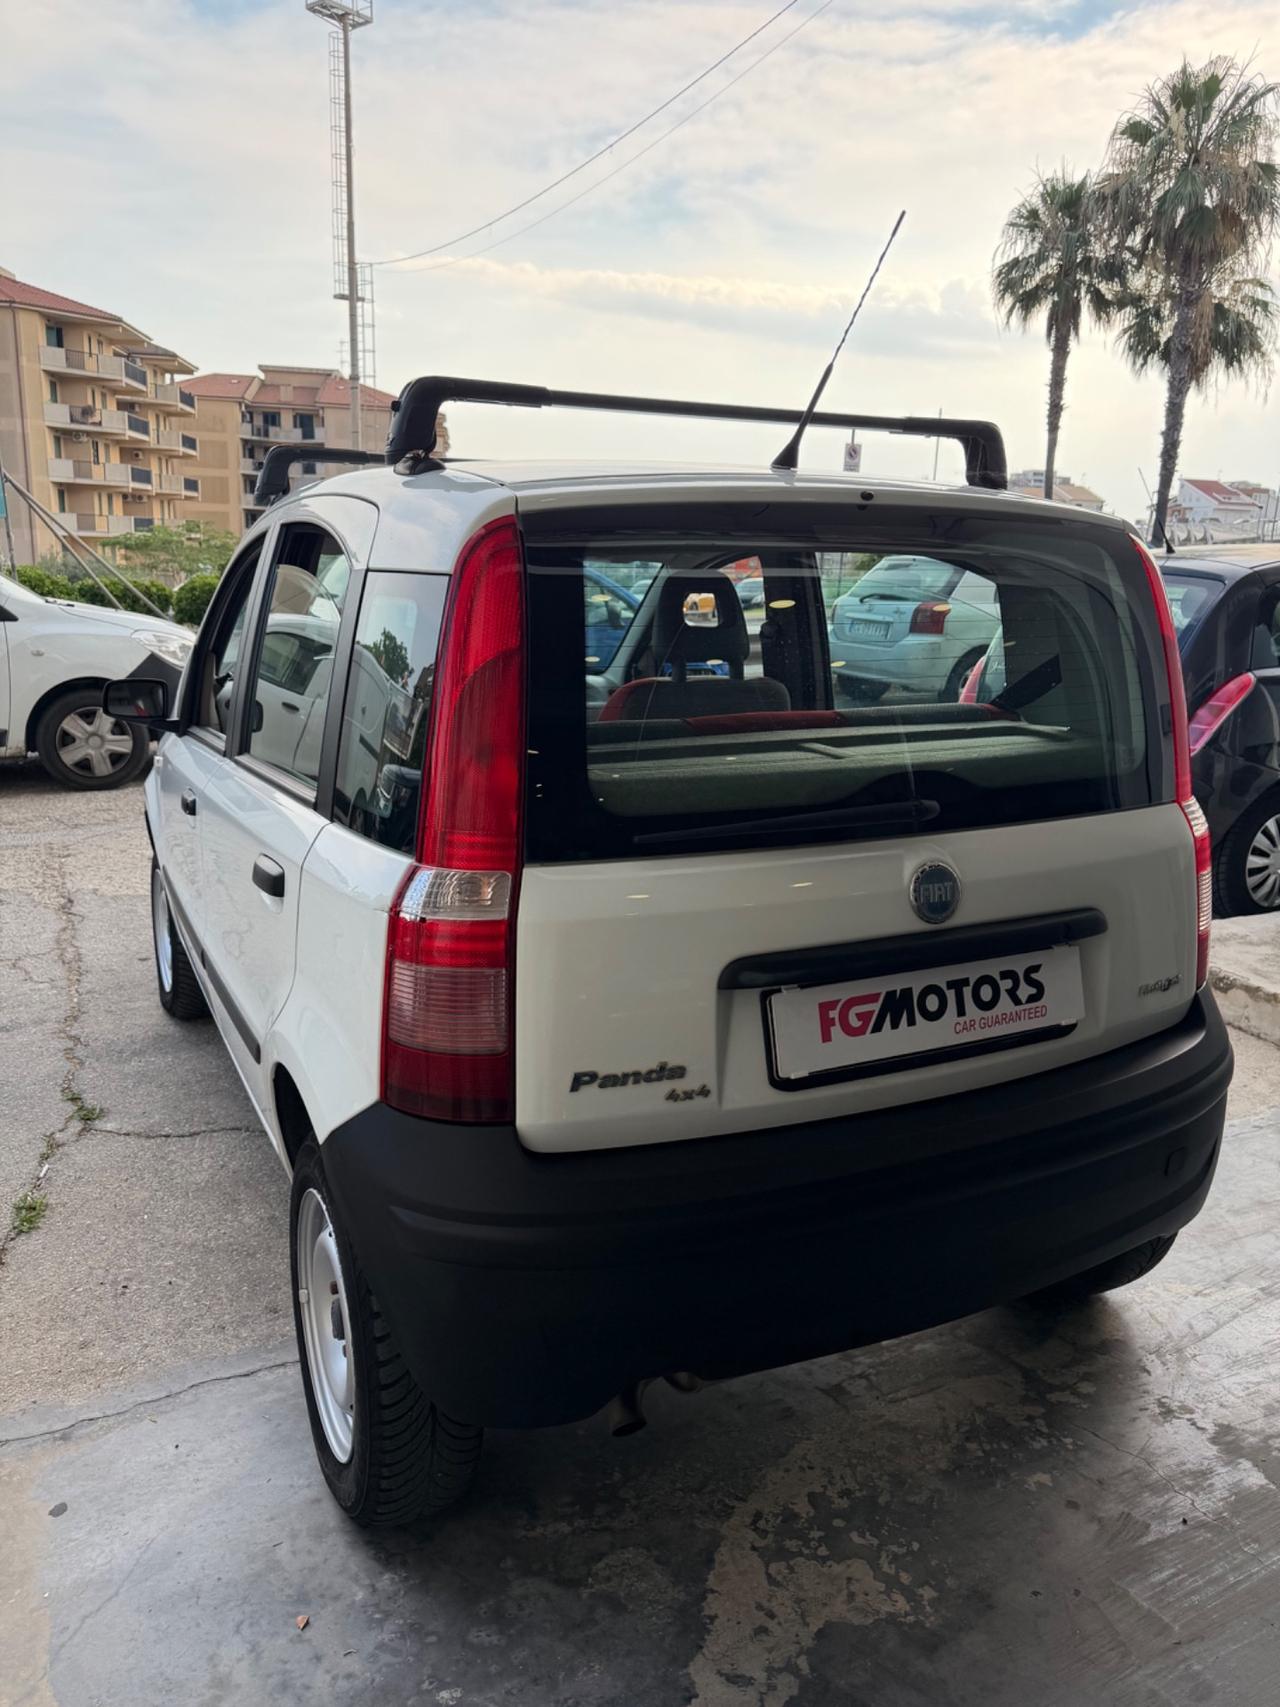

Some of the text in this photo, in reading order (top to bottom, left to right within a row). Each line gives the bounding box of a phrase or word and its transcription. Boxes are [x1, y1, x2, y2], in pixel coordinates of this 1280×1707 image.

[919, 881, 953, 904] FIAT
[953, 1004, 1048, 1035] CAR GUARANTEED
[569, 1061, 687, 1093] Panda
[664, 1084, 711, 1102] 4x4
